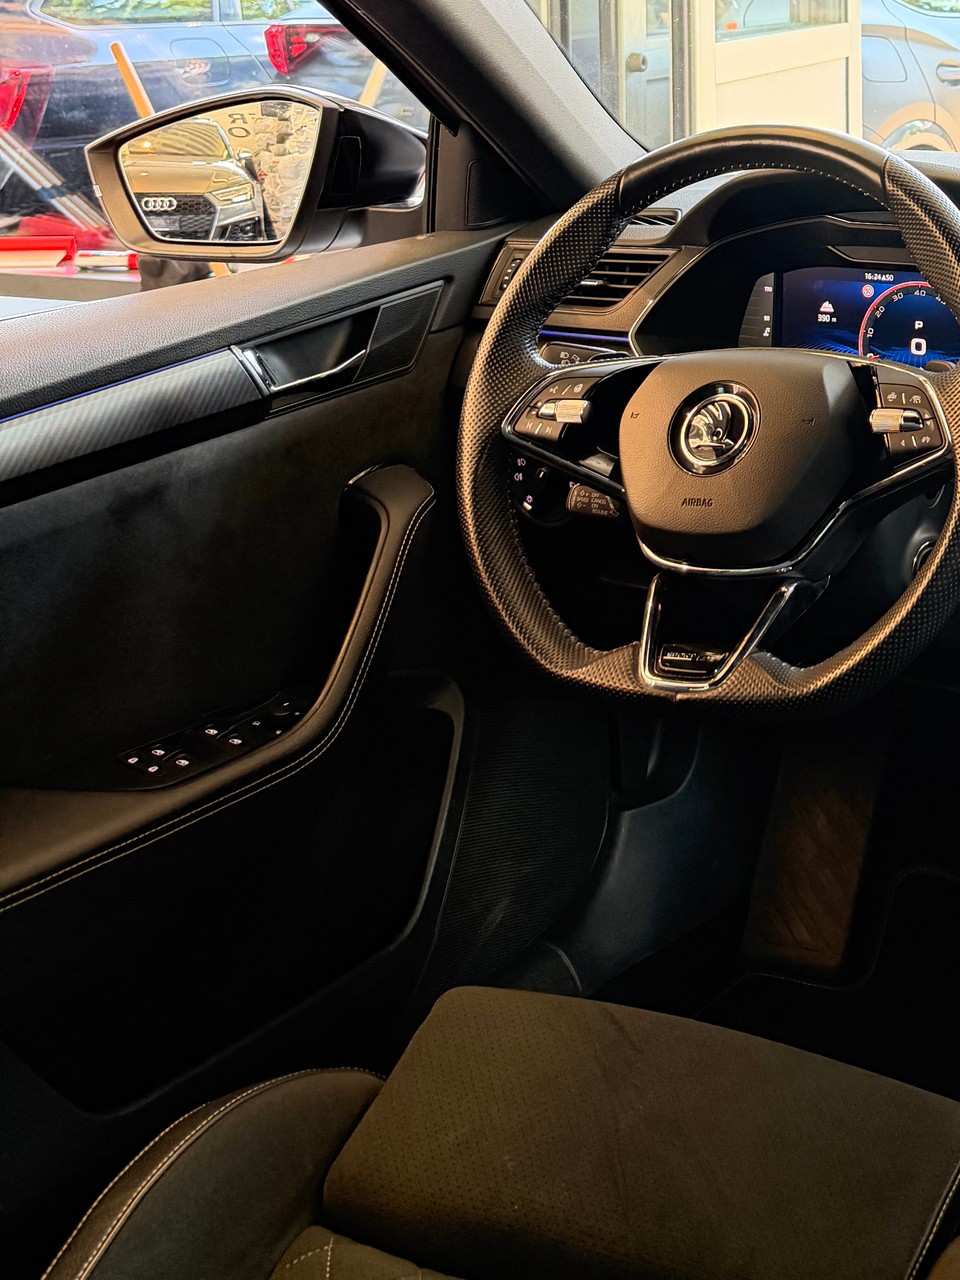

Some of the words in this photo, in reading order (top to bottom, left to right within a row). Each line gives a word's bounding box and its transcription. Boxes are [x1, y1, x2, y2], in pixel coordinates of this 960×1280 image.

[892, 292, 903, 302] 30
[875, 305, 885, 317] 20
[915, 321, 924, 329] P
[867, 328, 875, 338] 10
[911, 338, 927, 355] 0
[681, 497, 714, 508] AIRBAG
